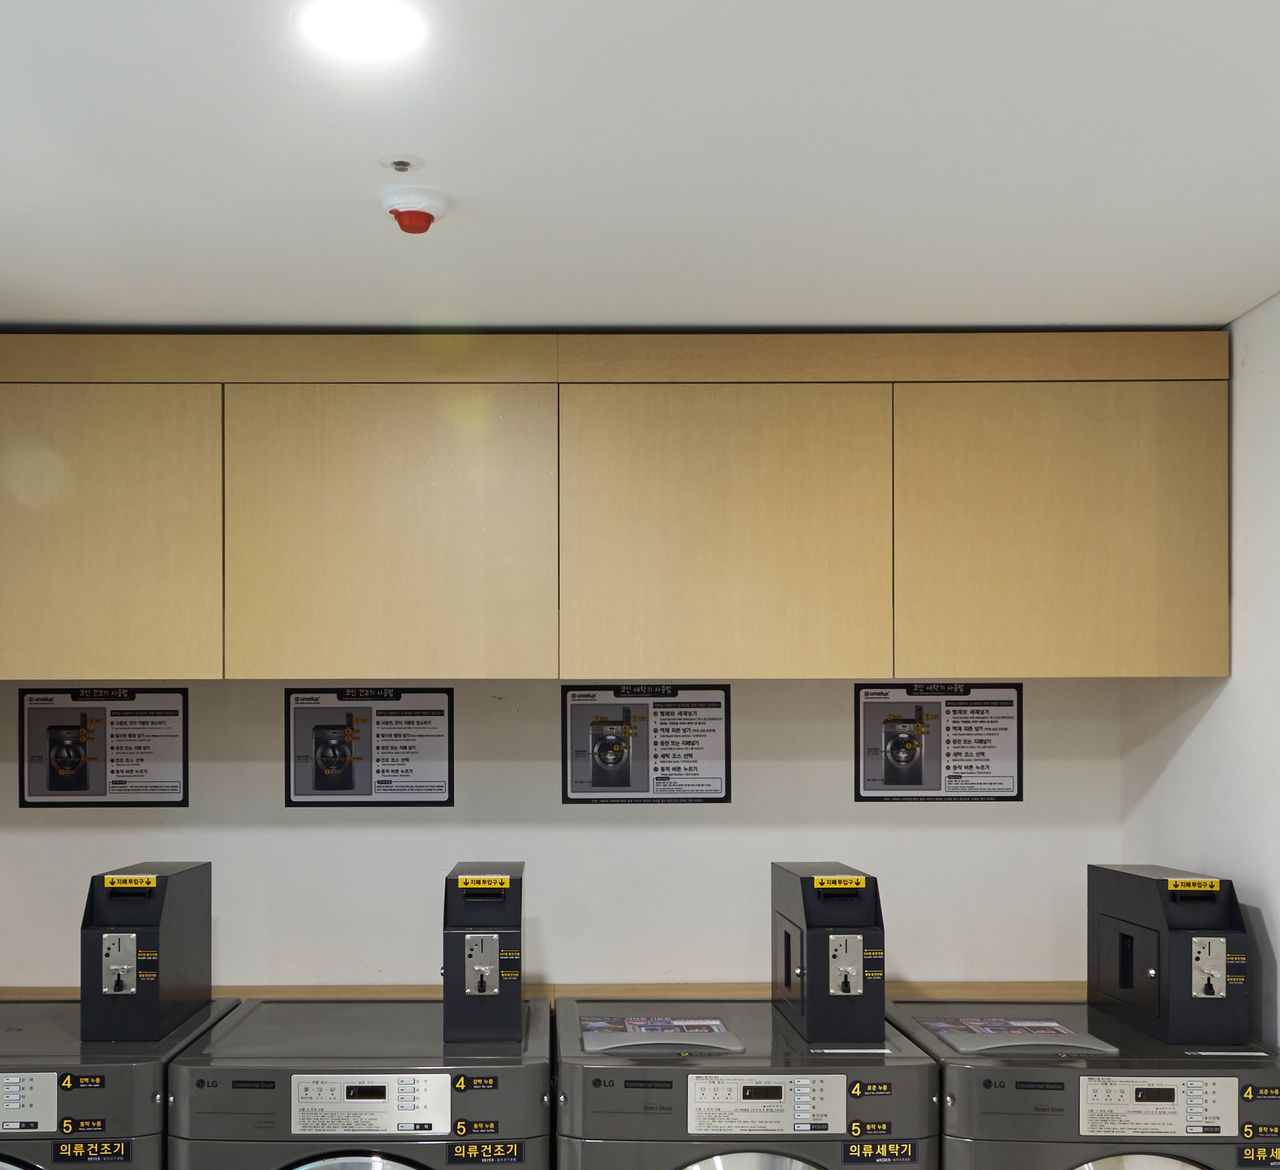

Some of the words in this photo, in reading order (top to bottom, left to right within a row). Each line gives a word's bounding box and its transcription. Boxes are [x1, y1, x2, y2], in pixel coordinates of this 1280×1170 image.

[61, 1075, 72, 1089] 4
[207, 1080, 218, 1088] LG
[455, 1076, 466, 1090] 4
[851, 1082, 861, 1096] 4
[1243, 1086, 1253, 1100] 4
[63, 1119, 72, 1134] 5
[457, 1121, 466, 1135] 5
[851, 1123, 861, 1136] 5
[1244, 1124, 1253, 1138] 5
[59, 1142, 124, 1157] 의류건조기
[454, 1143, 517, 1158] 의류건조기
[849, 1143, 912, 1157] 의류세탁기
